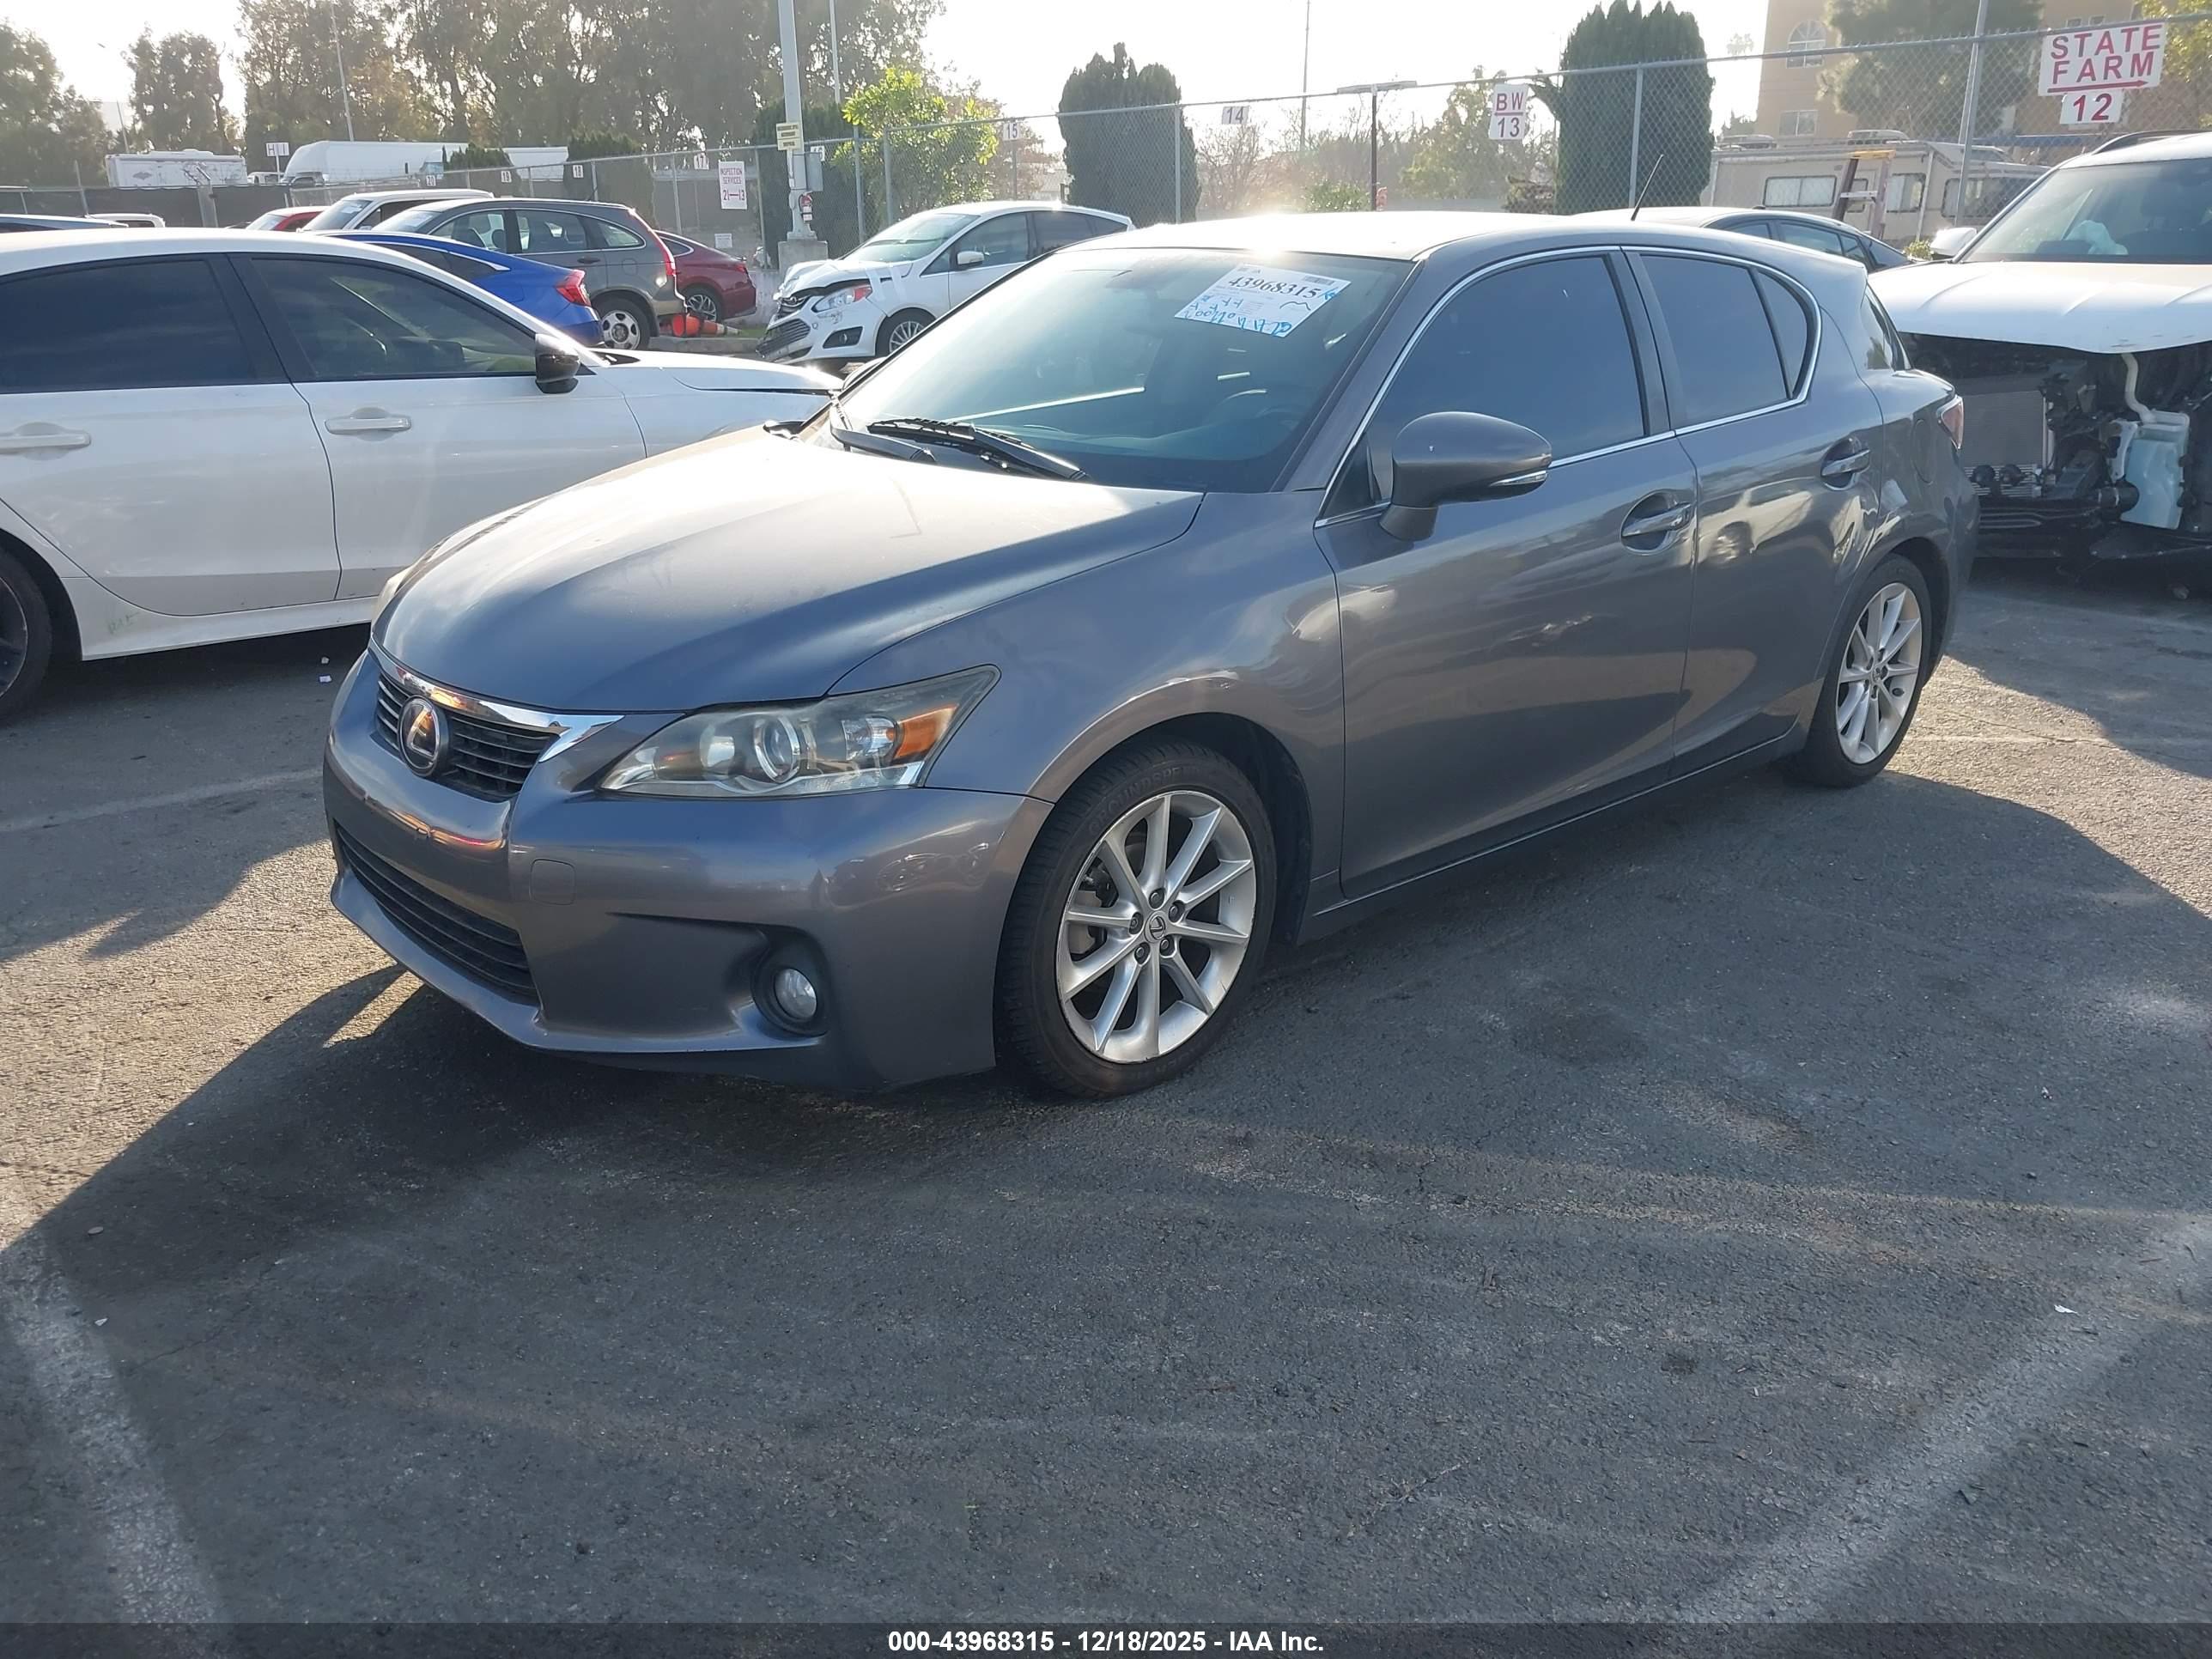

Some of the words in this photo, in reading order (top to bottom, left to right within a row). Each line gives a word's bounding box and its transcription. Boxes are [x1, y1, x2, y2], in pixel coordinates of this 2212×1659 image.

[2050, 24, 2163, 60] STATE
[2052, 51, 2155, 85] FARM
[1496, 91, 1524, 111] BW
[2072, 93, 2113, 122] 12
[1226, 106, 1244, 125] 14
[1006, 123, 1018, 139] 15
[1497, 117, 1520, 138] 13
[1228, 276, 1322, 300] 43968315
